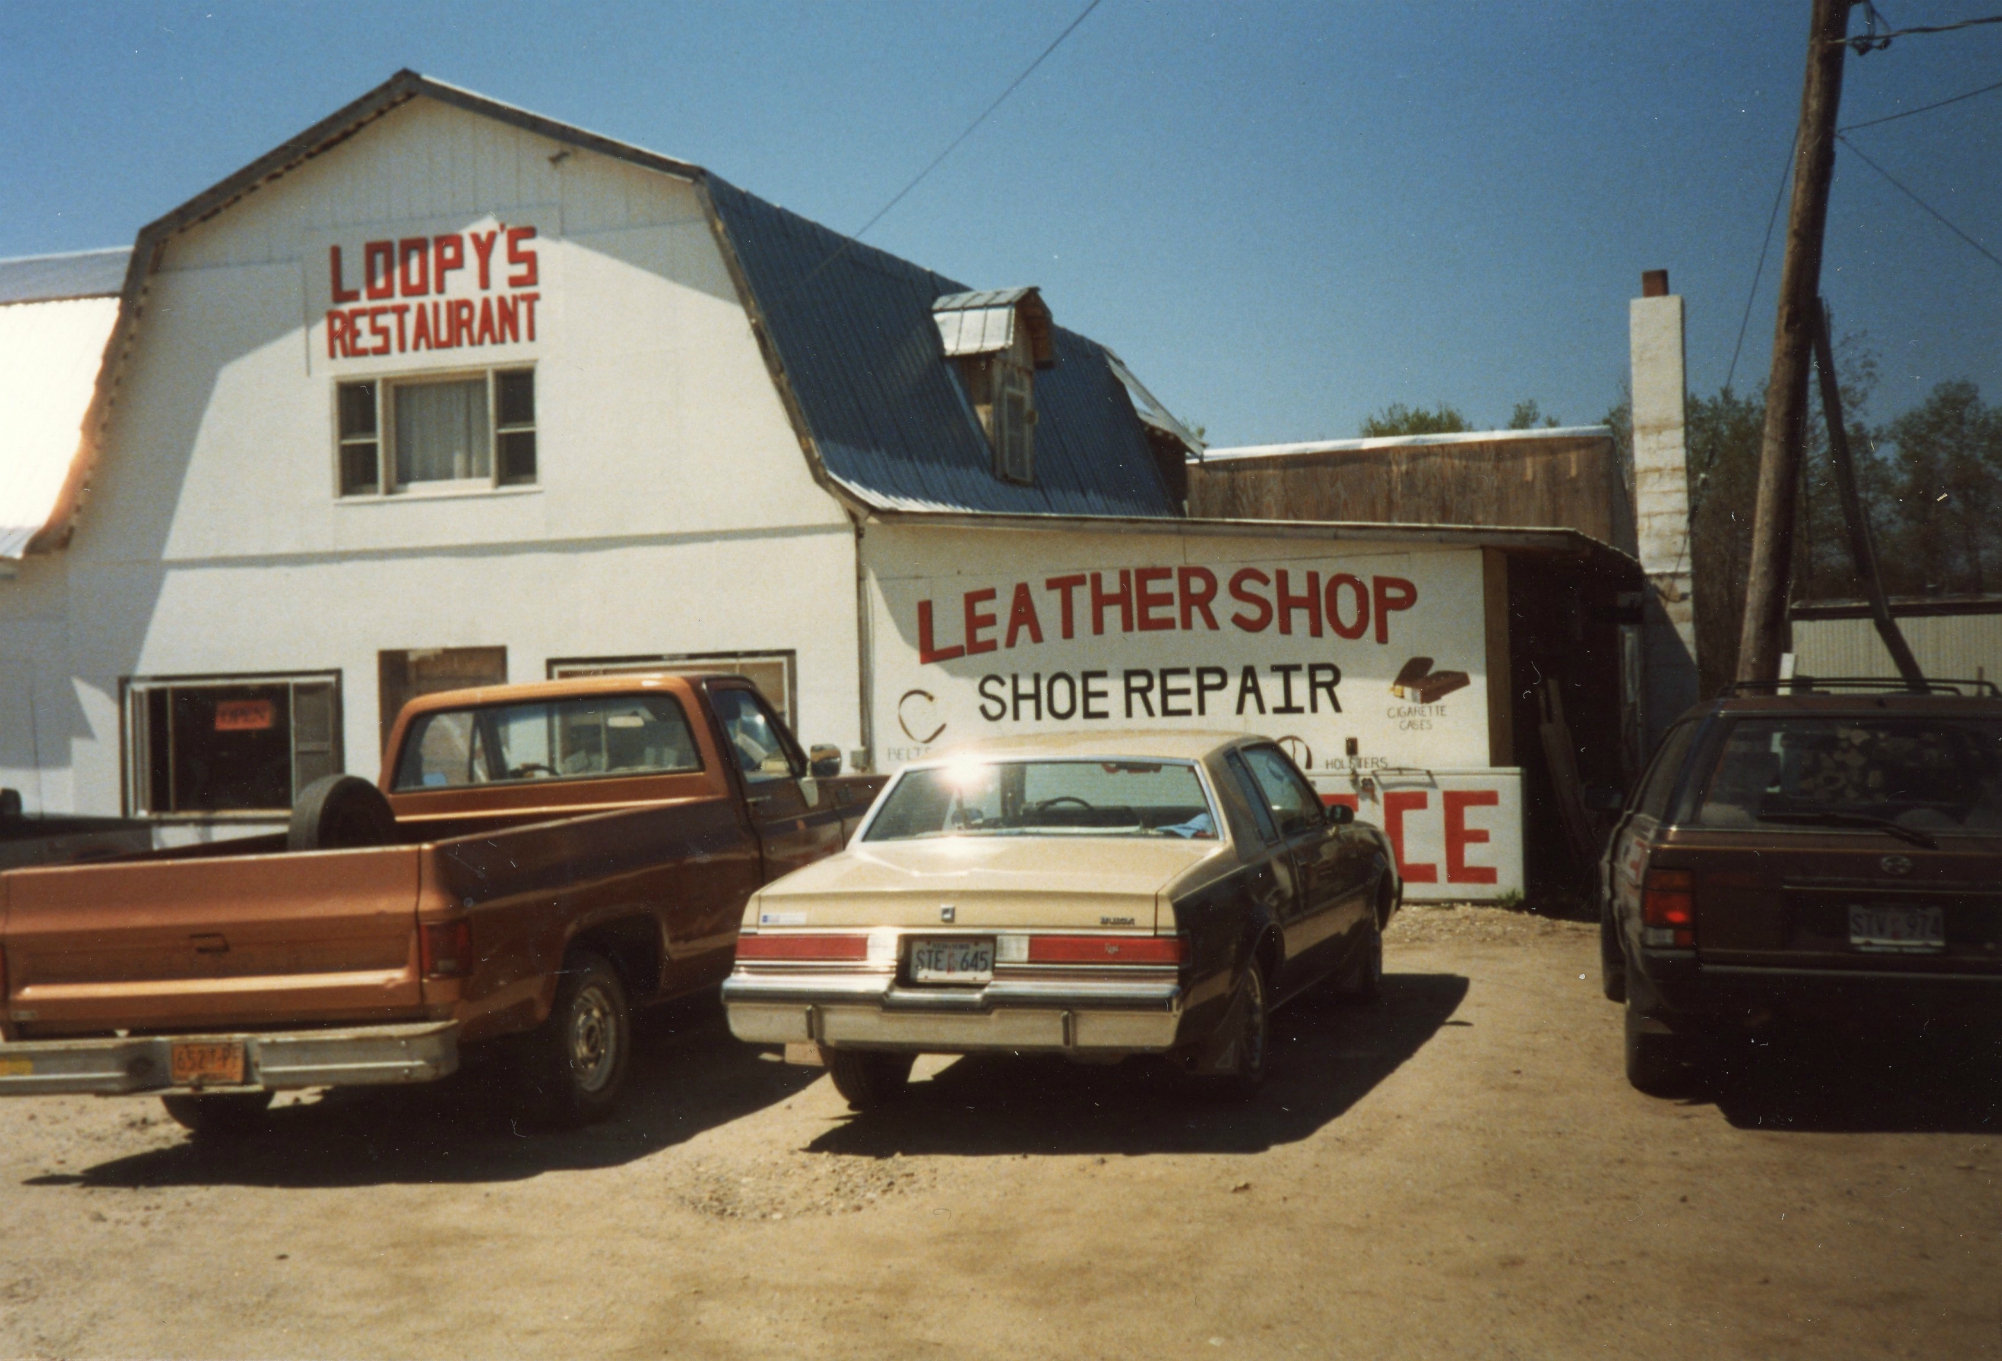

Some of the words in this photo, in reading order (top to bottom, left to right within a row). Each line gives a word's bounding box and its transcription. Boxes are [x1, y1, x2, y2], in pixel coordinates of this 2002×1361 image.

[330, 222, 539, 303] LOOPY'S
[326, 292, 540, 359] RESTAURANT
[917, 566, 1220, 664] LEATHER
[1228, 567, 1418, 644] SHOP
[978, 671, 1110, 722] SHOE
[1124, 662, 1343, 717] REPAIR
[1387, 705, 1448, 719] CIGARETTE
[1399, 719, 1434, 731] CASES
[1325, 756, 1388, 770] HOLSTERS
[1320, 789, 1499, 884] CE
[915, 949, 944, 971] STE
[960, 950, 989, 972] 645
